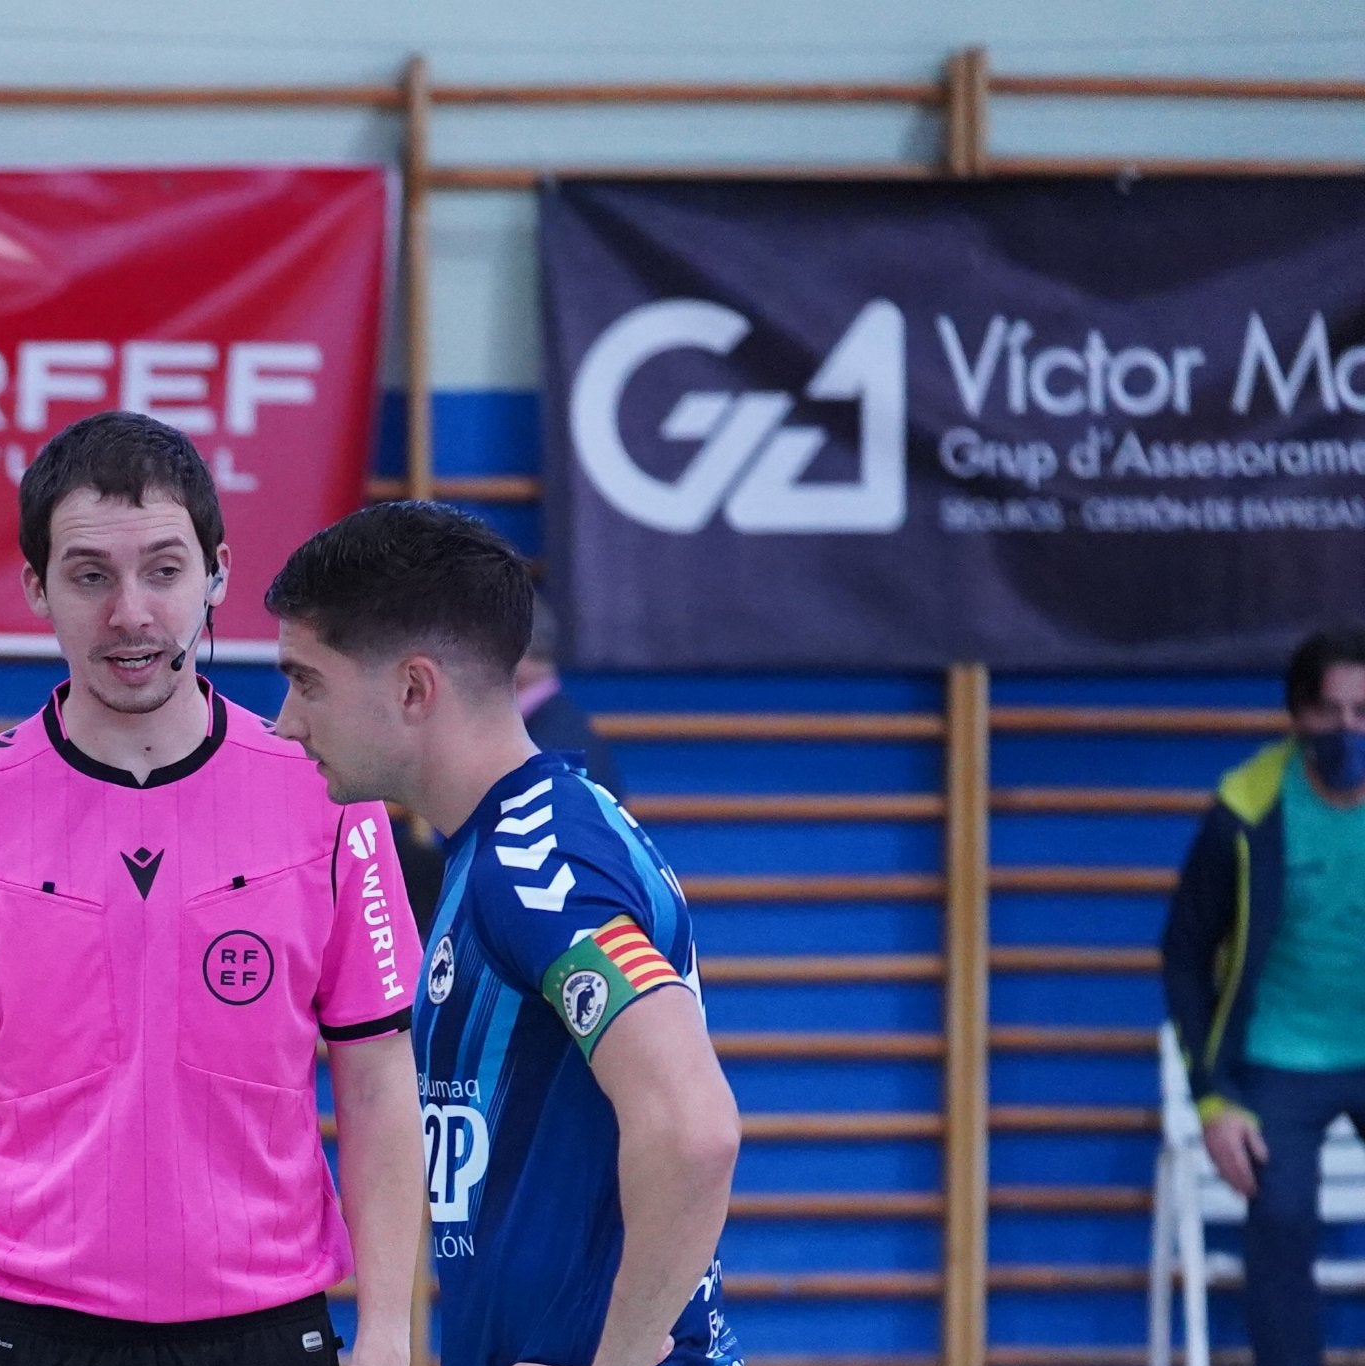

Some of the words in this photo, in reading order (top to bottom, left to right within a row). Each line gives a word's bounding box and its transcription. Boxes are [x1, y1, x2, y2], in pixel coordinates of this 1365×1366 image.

[936, 311, 1205, 417] Víctor
[938, 425, 1059, 490] Grup
[362, 863, 405, 1000] WÜRTH
[434, 1230, 475, 1258] LÓN
